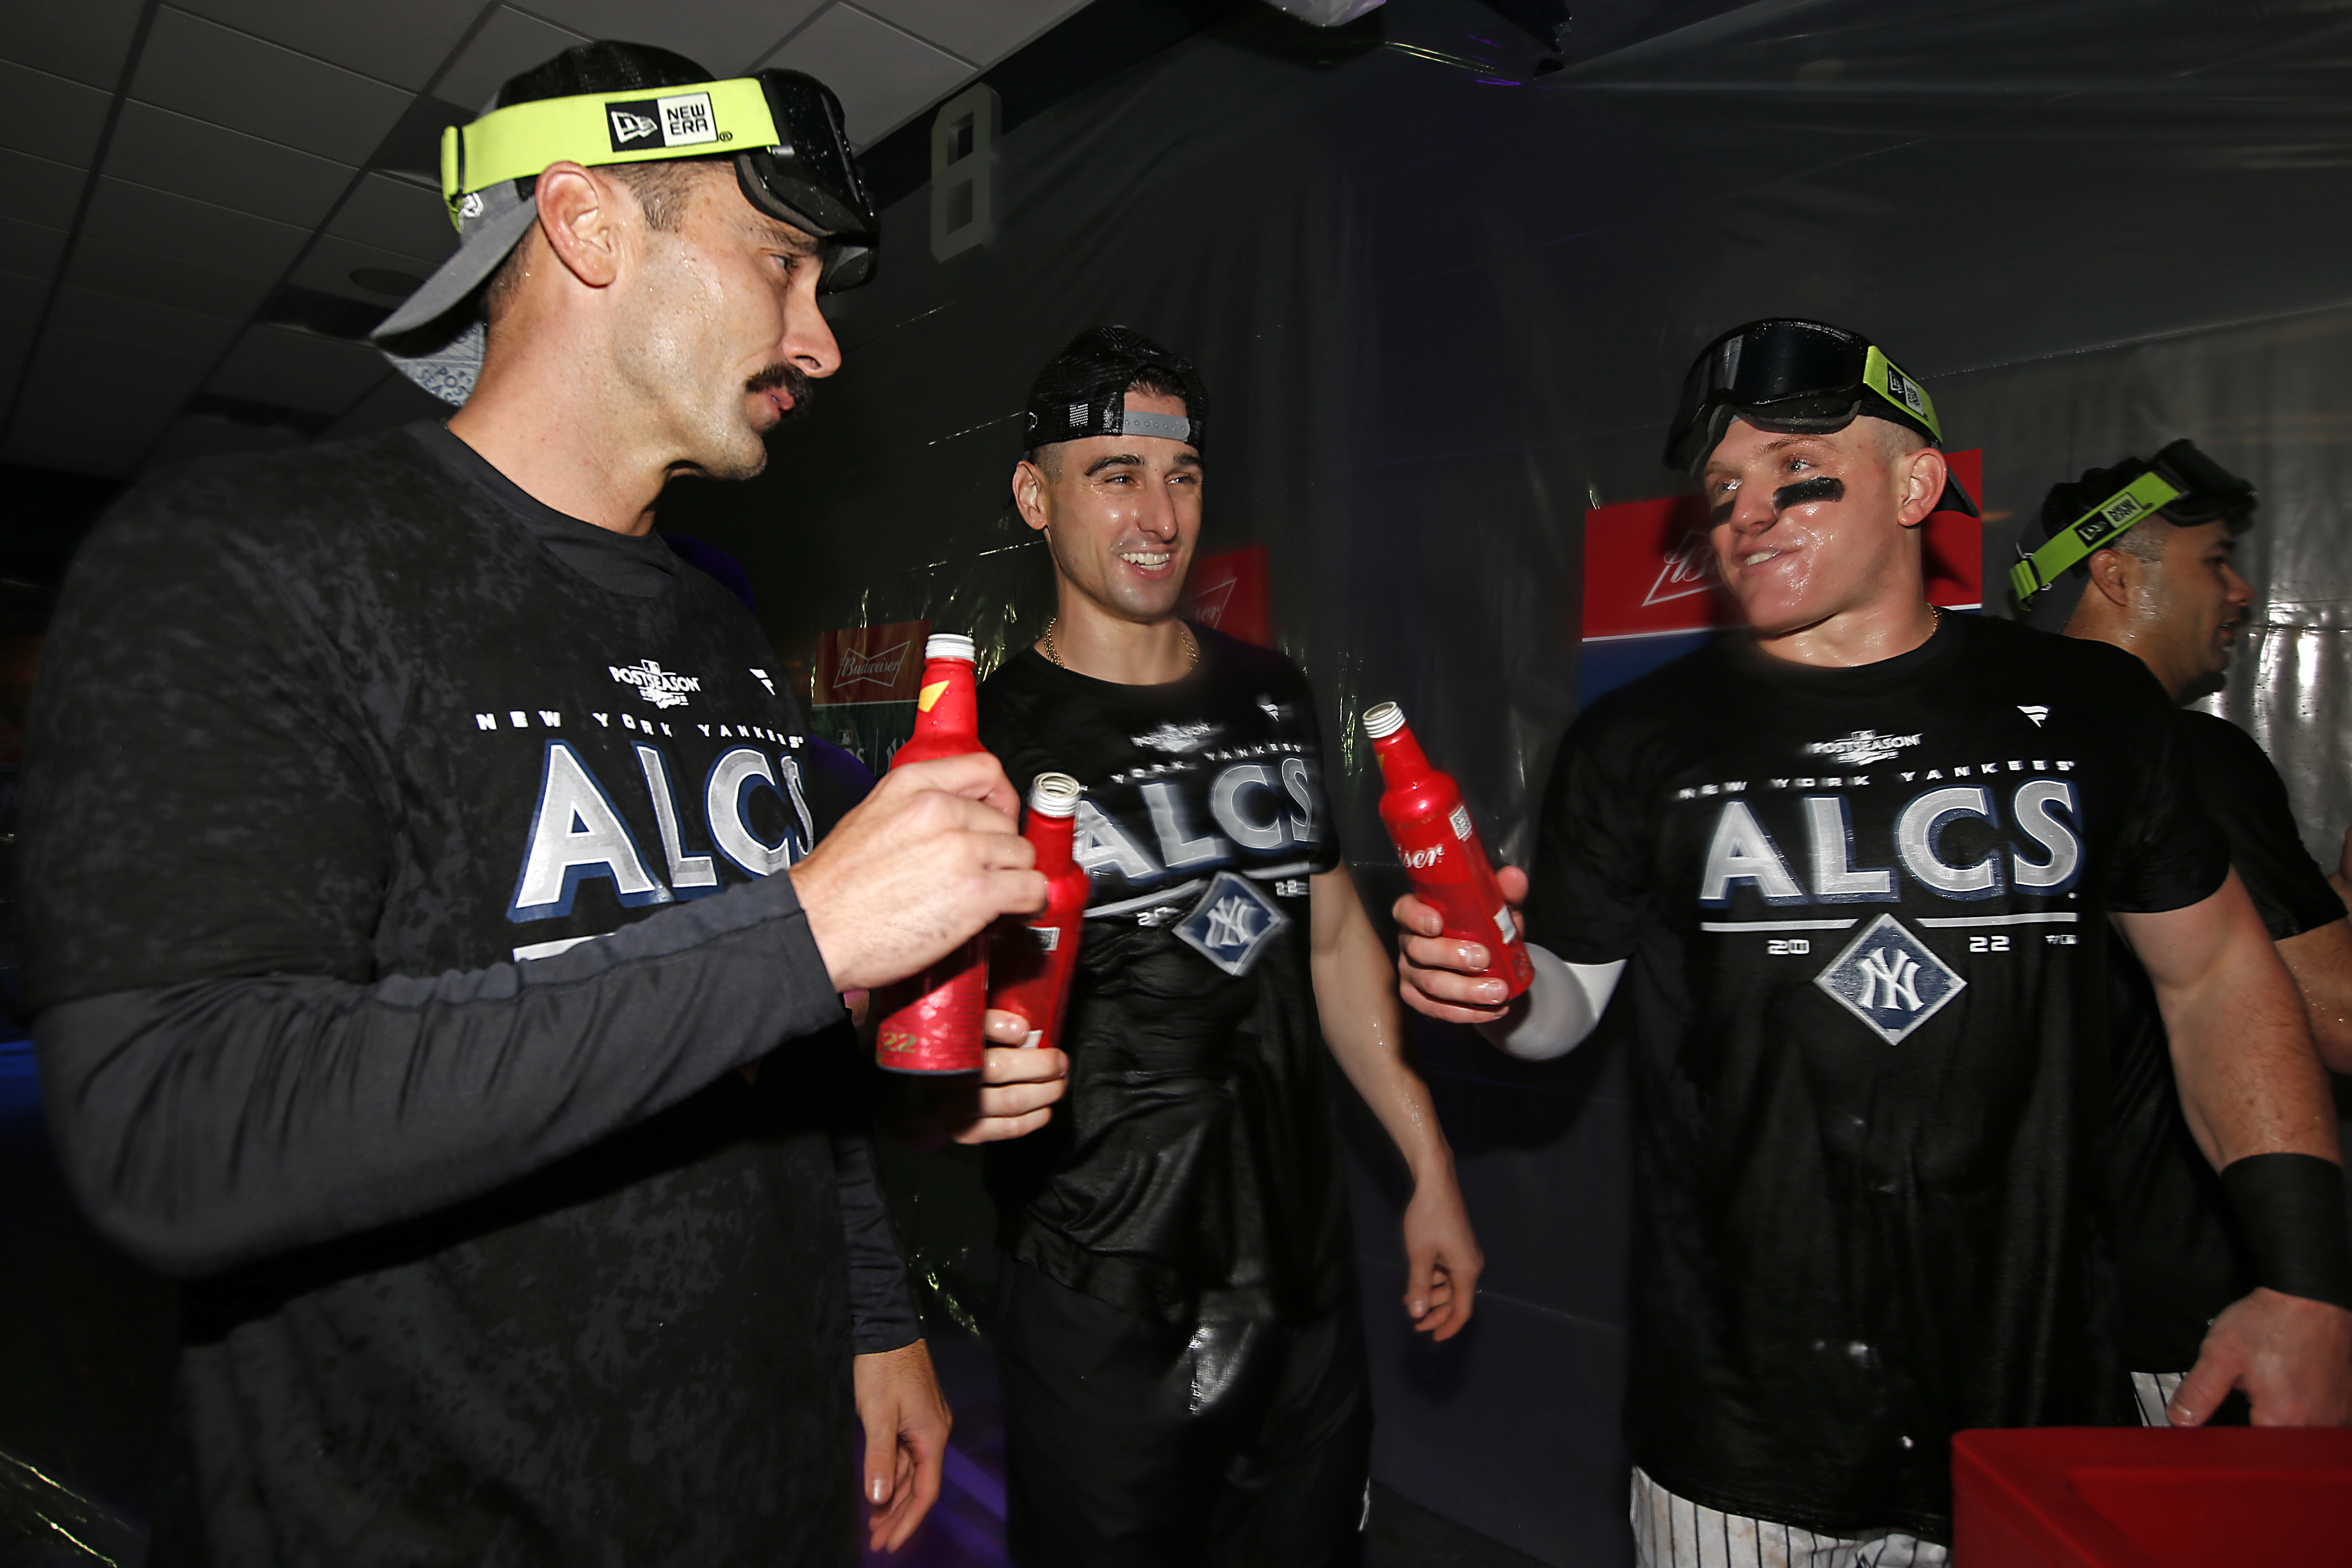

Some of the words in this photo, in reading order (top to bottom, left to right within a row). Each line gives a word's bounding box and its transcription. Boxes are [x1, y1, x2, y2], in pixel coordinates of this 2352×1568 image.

[666, 104, 705, 121] NEW
[670, 118, 708, 136] ERA
[2107, 499, 2132, 517] NEW
[840, 657, 902, 677] Budweiser
[609, 666, 701, 692] POSTSEASON
[475, 710, 561, 730] NEW
[593, 713, 672, 737] YORK
[1810, 733, 1923, 754] POSTSEASON
[1110, 761, 1186, 784] YORK
[1679, 781, 1748, 799] NEW
[1770, 775, 1870, 788] YORK
[1901, 760, 2072, 782] YANKEES
[1072, 758, 1312, 878] ALCS
[506, 740, 815, 922] ALCS
[1699, 779, 2082, 904] ALCS
[1767, 939, 1810, 955] 20
[1969, 936, 2010, 952] 22
